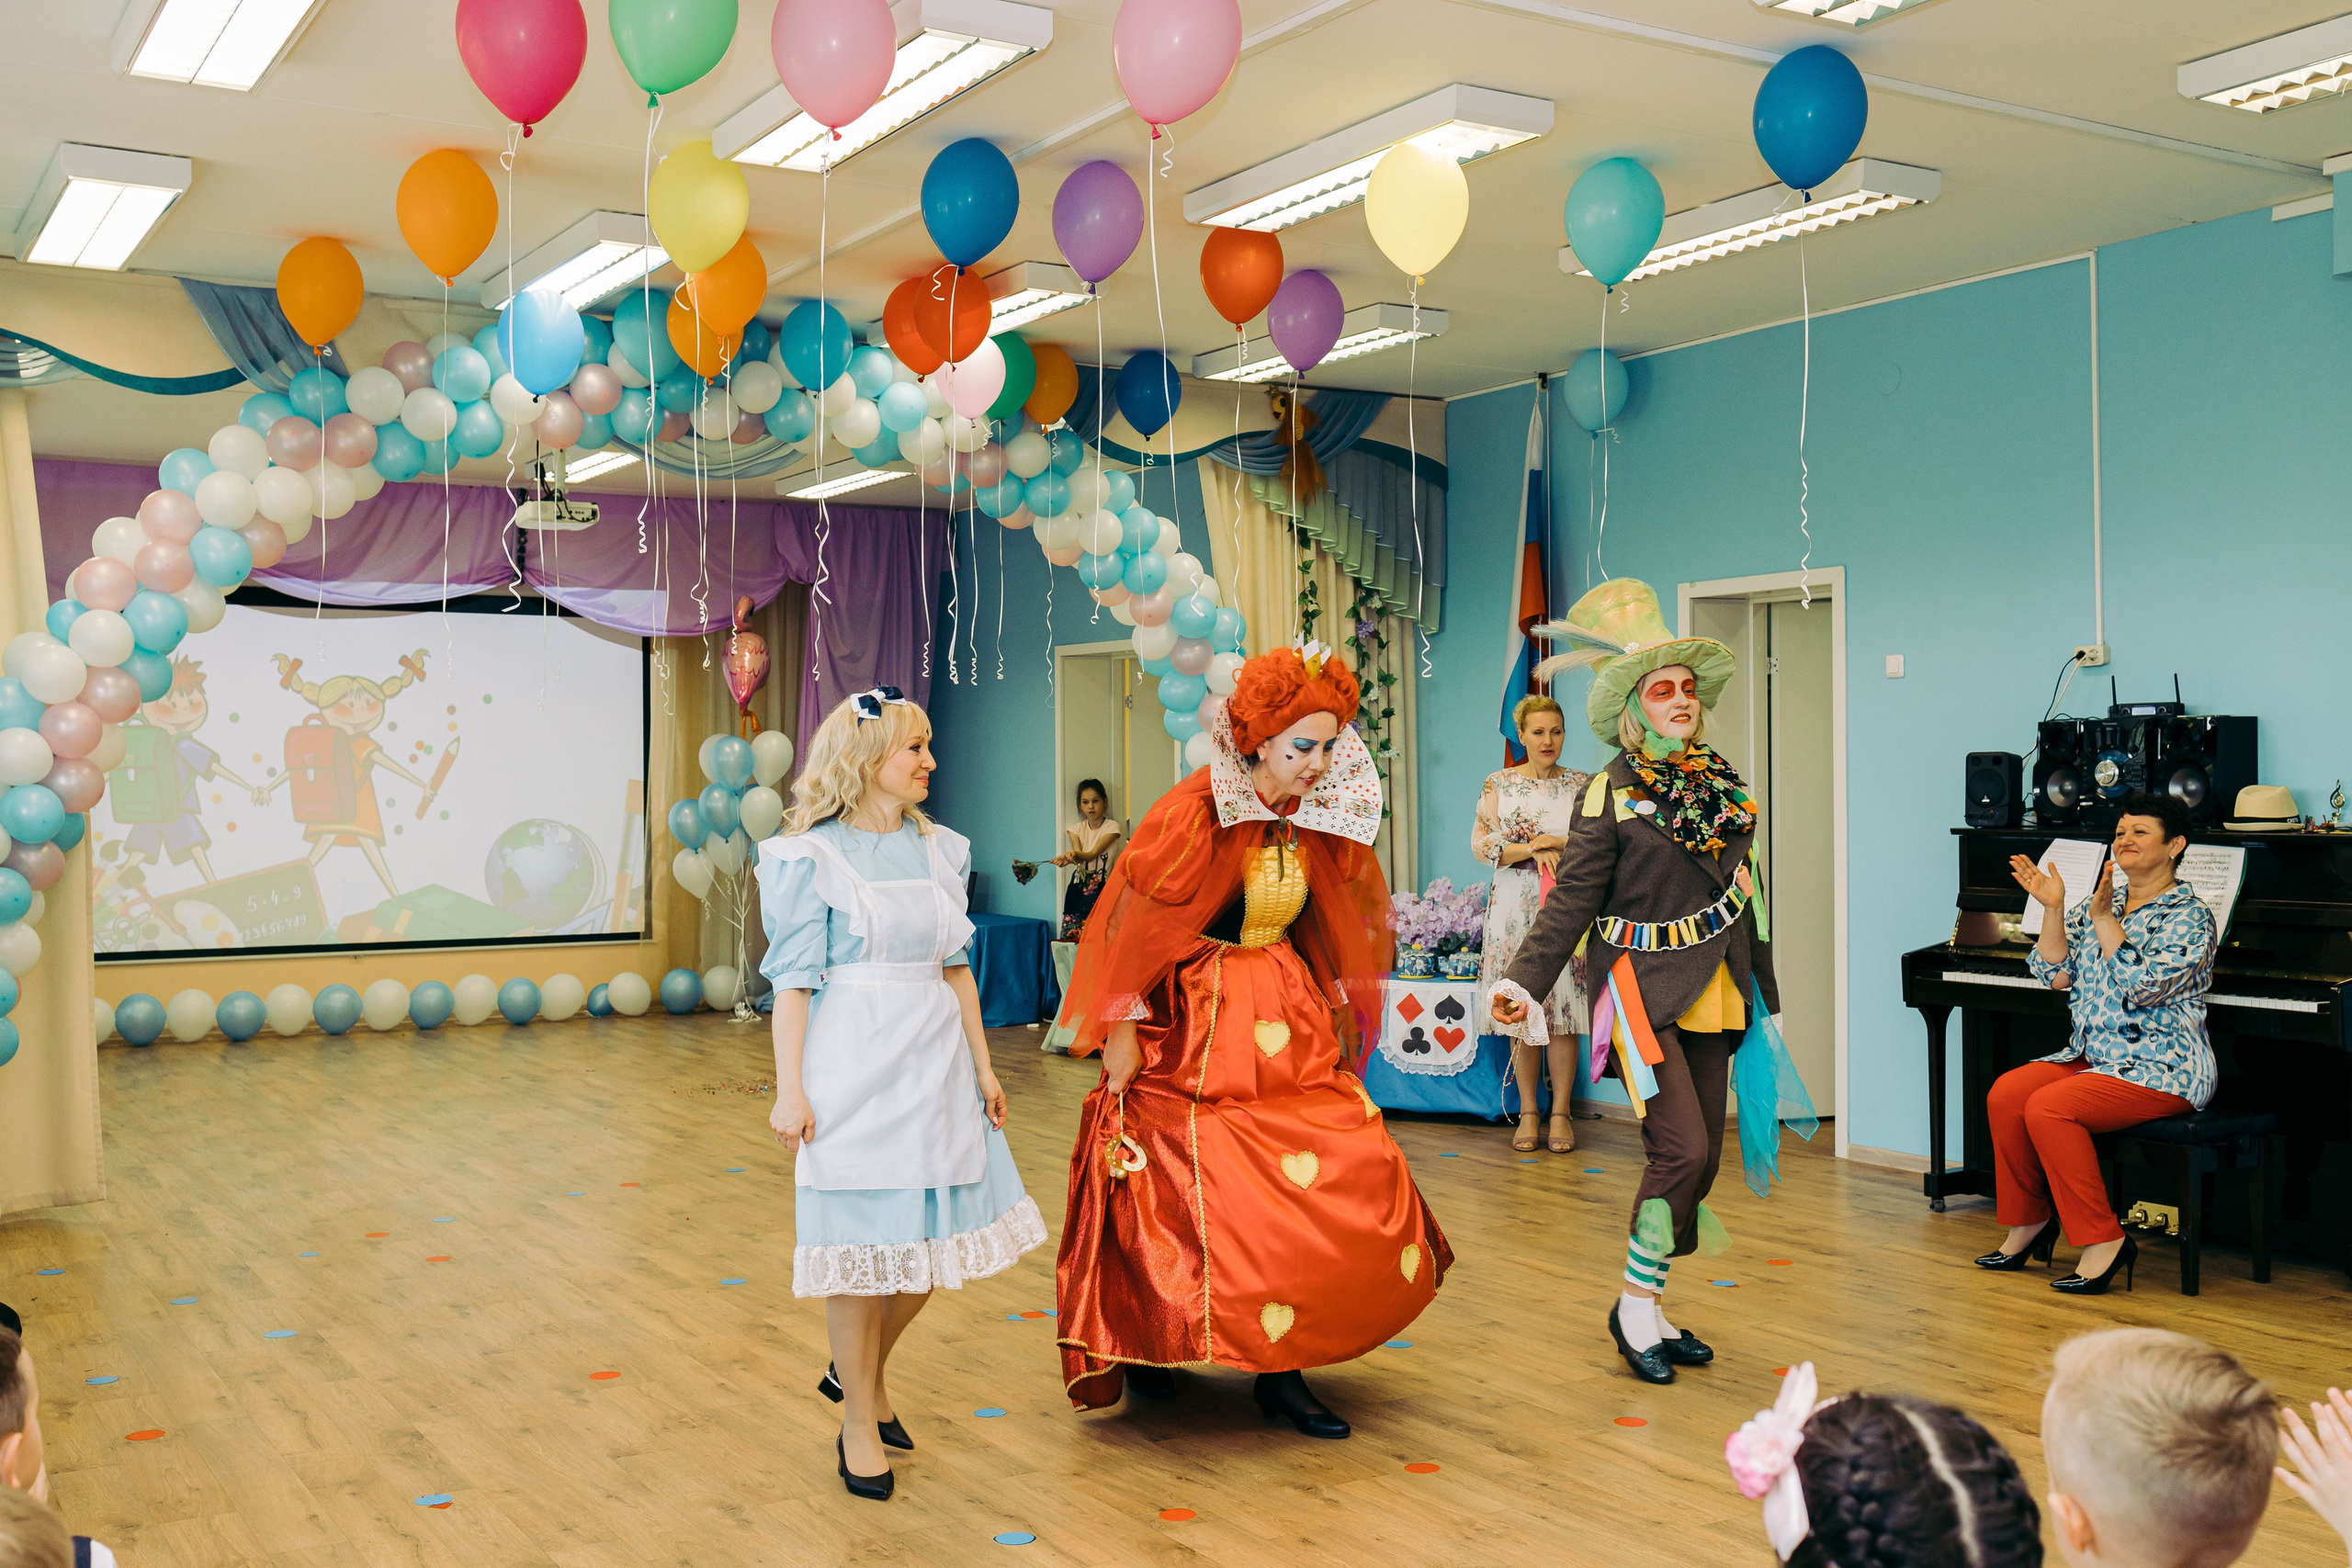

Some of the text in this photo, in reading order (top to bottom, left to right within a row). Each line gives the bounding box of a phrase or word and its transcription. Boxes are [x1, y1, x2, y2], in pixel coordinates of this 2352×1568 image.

[246, 895, 257, 912] 5
[271, 888, 278, 907] 4
[293, 886, 301, 900] 9
